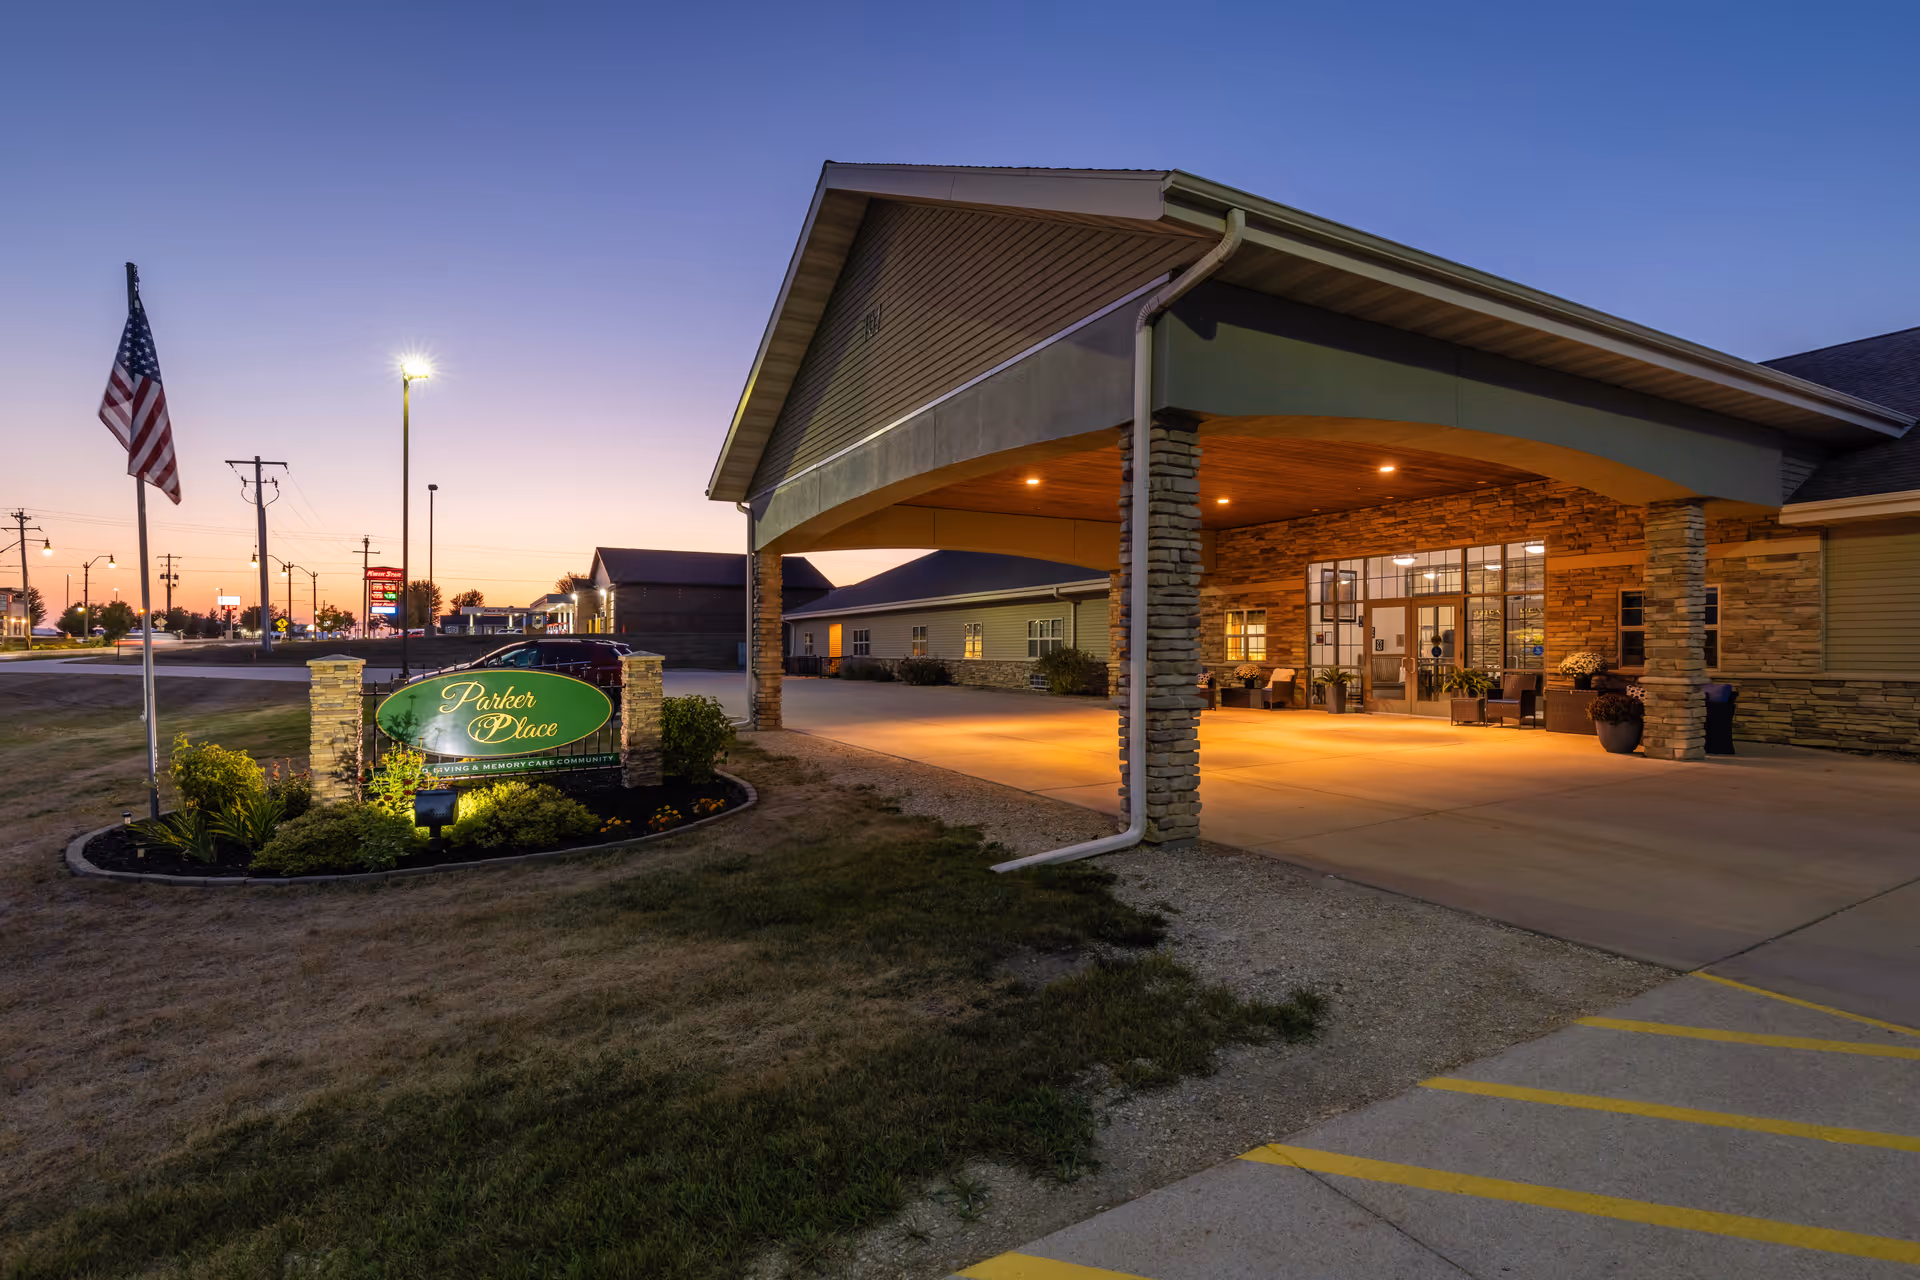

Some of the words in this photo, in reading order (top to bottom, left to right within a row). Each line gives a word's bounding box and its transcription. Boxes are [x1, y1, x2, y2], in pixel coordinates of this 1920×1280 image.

[439, 680, 537, 713] Parker
[467, 712, 558, 744] Place
[482, 761, 526, 770] MEMORY
[528, 759, 555, 767] CARE
[556, 755, 614, 765] COMMUNITY
